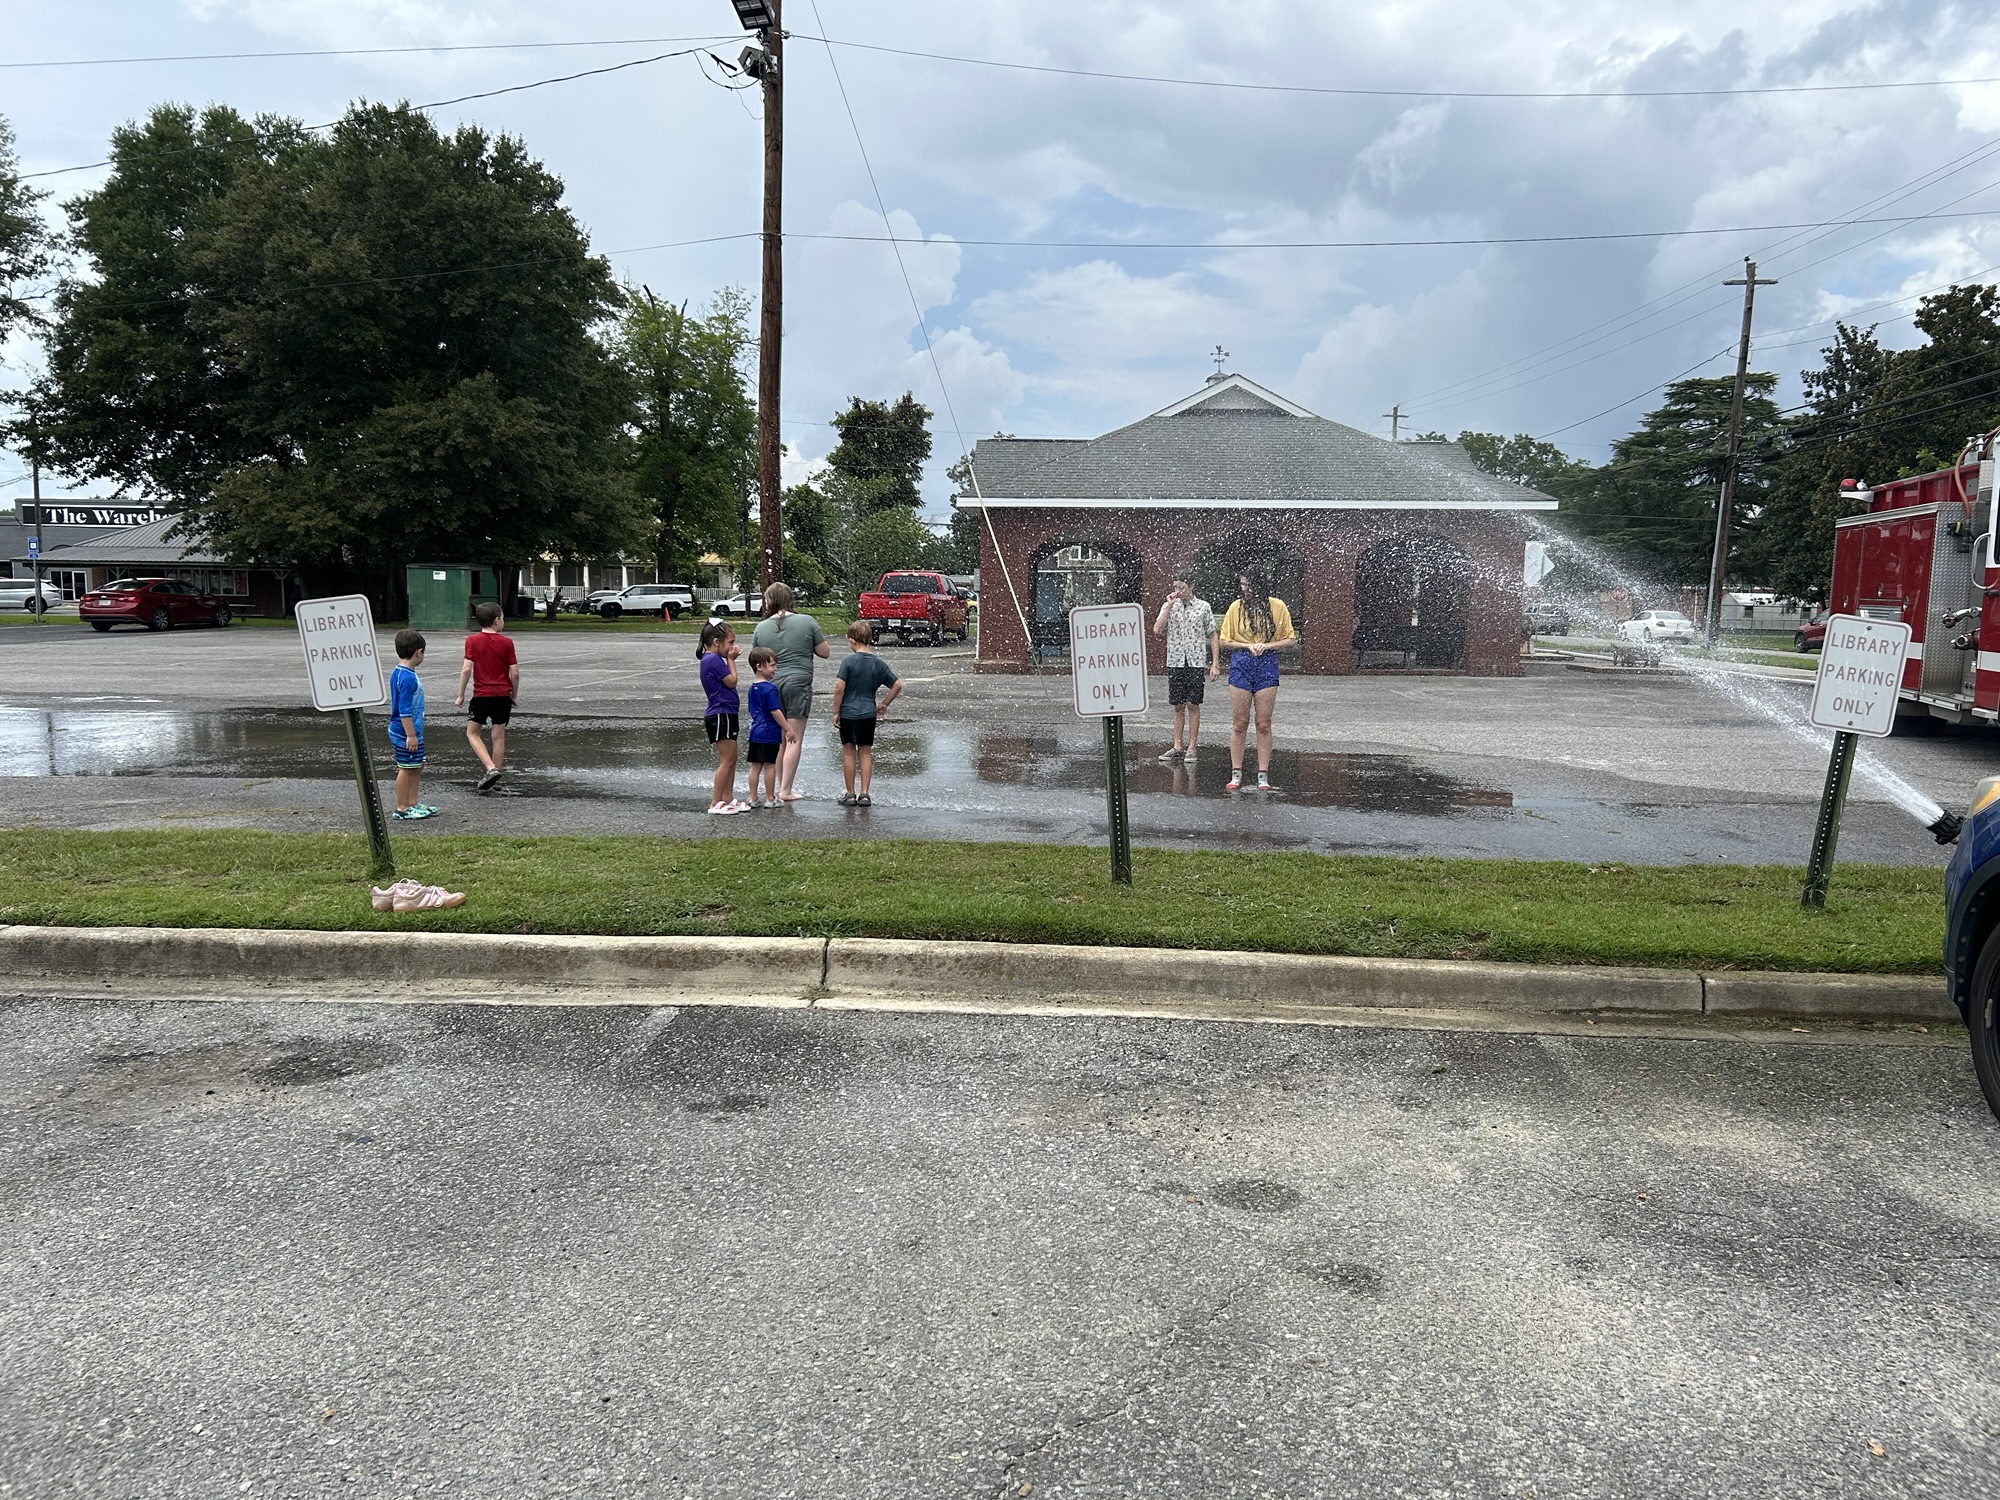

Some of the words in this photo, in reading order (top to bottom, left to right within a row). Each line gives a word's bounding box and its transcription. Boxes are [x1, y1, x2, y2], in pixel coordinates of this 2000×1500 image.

[46, 508, 87, 524] The
[304, 612, 364, 633] LIBRARY
[1076, 621, 1137, 640] LIBRARY
[310, 643, 372, 663] PARKING
[1830, 632, 1901, 656] LIBRARY
[1078, 652, 1140, 670] PARKING
[328, 674, 364, 691] ONLY
[1824, 664, 1895, 687] PARKING
[1092, 683, 1128, 699] ONLY
[1832, 697, 1875, 716] ONLY
